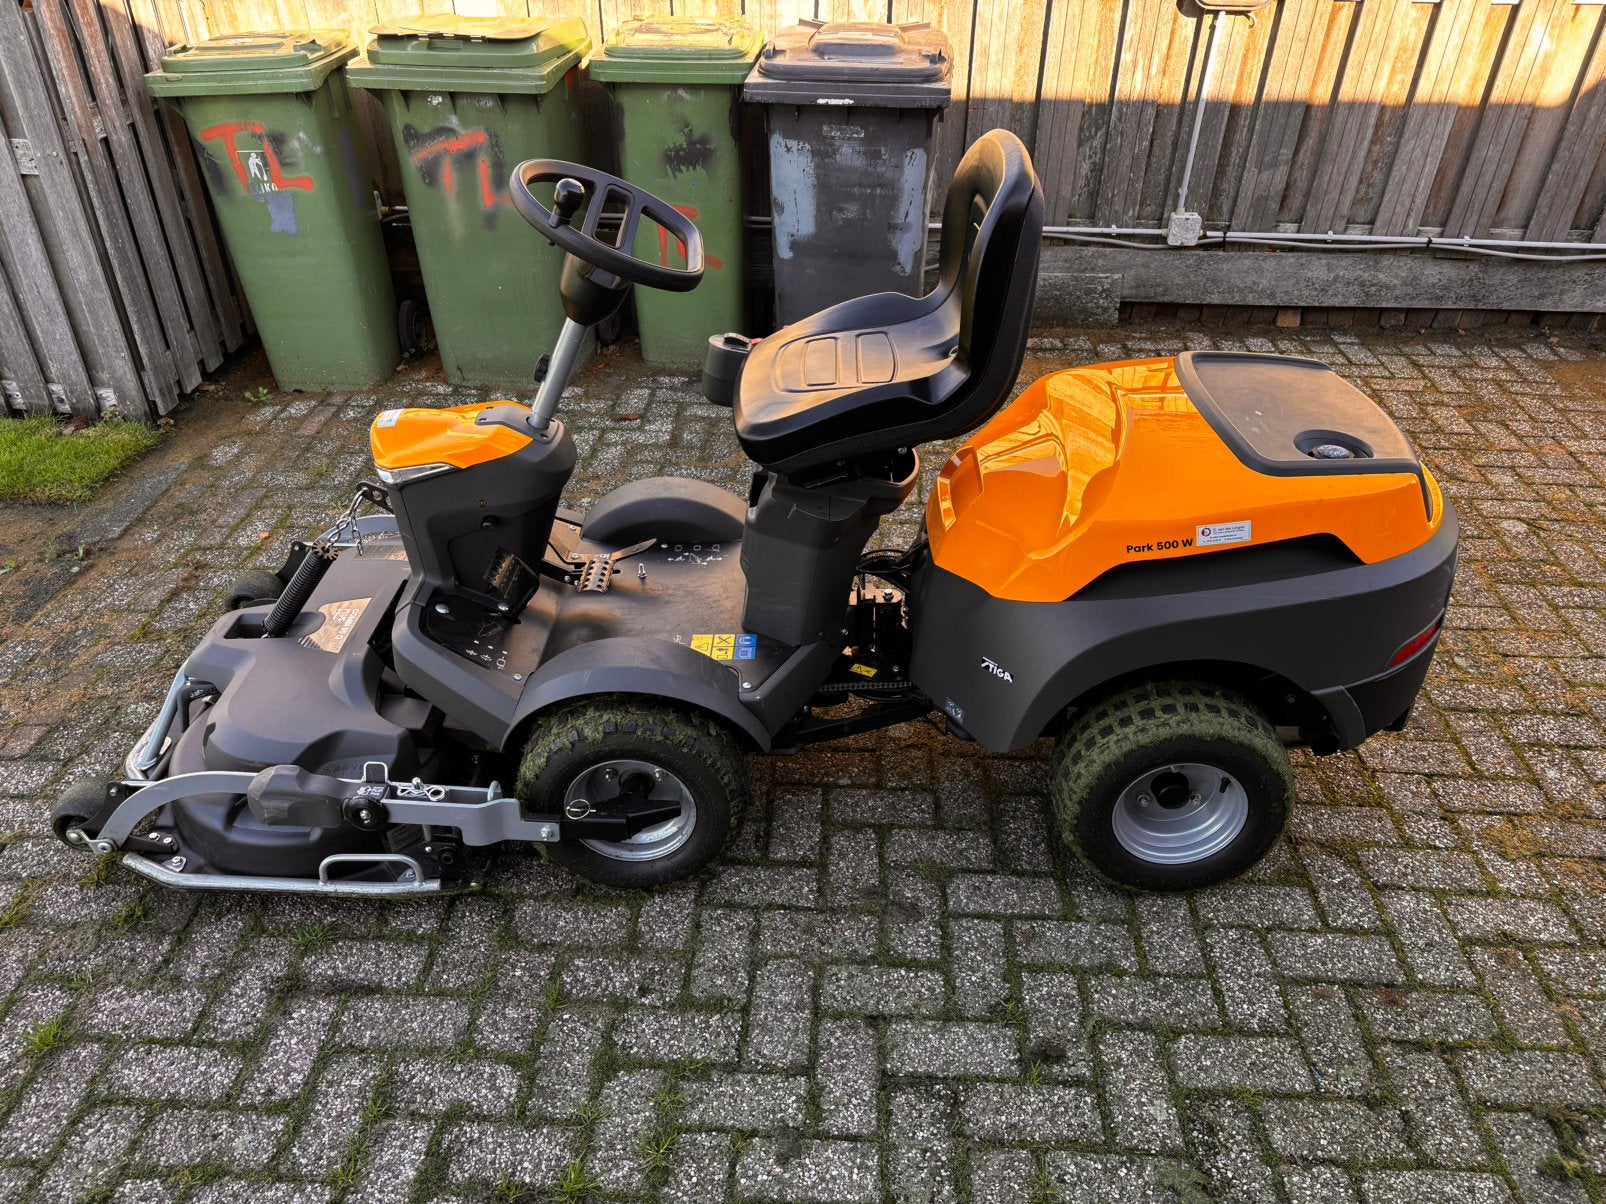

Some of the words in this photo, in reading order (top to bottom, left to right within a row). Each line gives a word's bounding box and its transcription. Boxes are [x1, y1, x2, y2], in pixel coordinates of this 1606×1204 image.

[199, 123, 314, 195] TL
[1126, 542, 1154, 553] Park
[1156, 539, 1179, 551] 500
[1181, 538, 1194, 548] W
[981, 656, 1013, 683] STIGA
